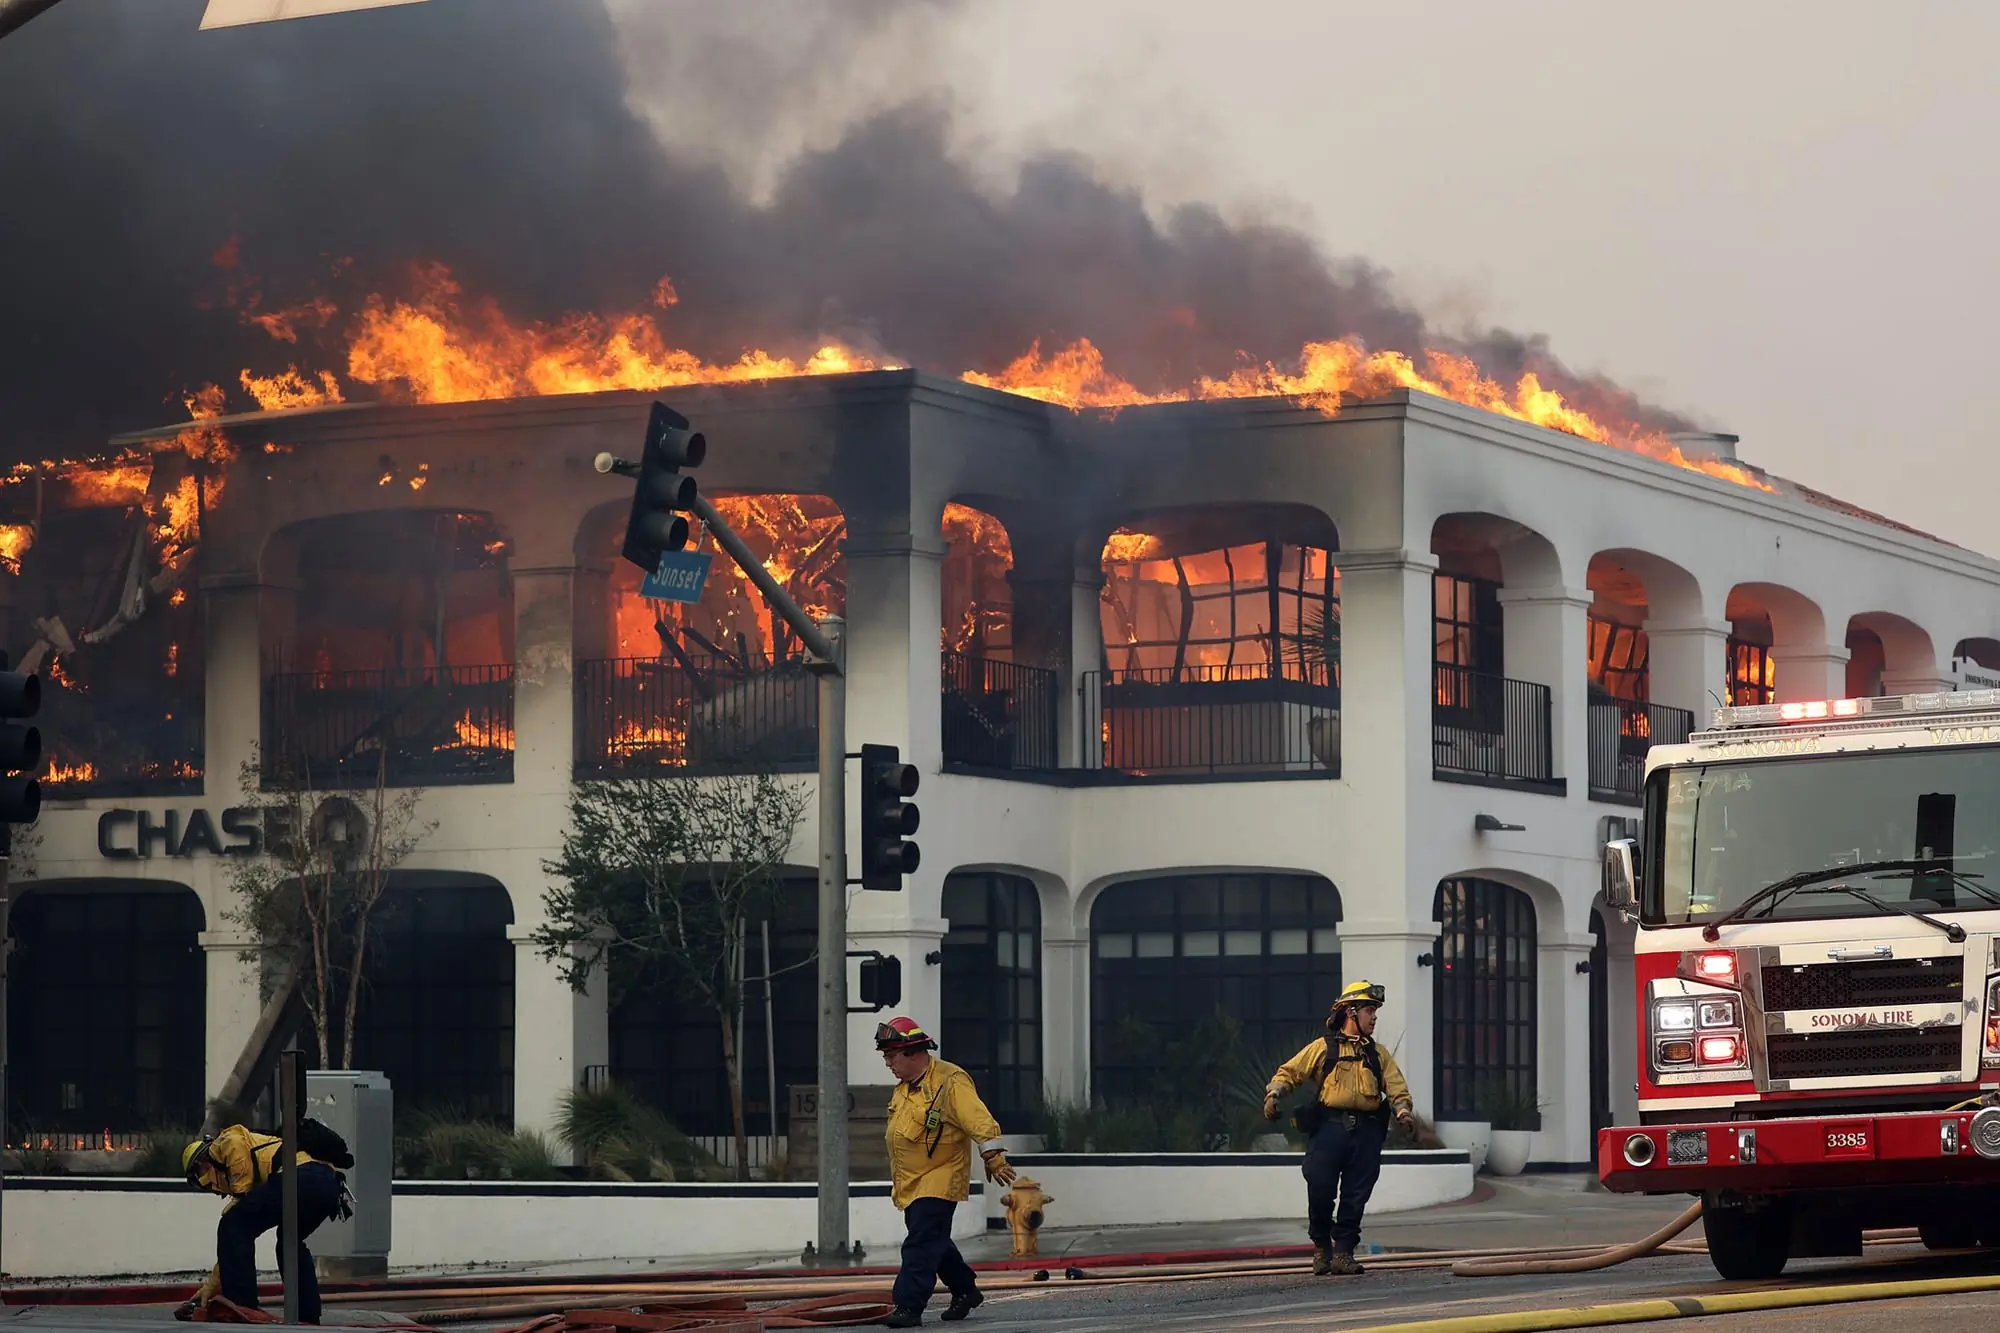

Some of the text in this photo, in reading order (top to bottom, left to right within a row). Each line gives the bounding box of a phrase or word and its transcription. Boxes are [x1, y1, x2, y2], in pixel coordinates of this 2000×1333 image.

[652, 560, 702, 591] Sunset
[1708, 734, 1823, 759] SONOMA
[97, 806, 302, 859] CHASE
[1811, 1010, 1913, 1027] SONOMA FIRE
[796, 1092, 855, 1114] 150
[1827, 1132, 1867, 1147] 3385
